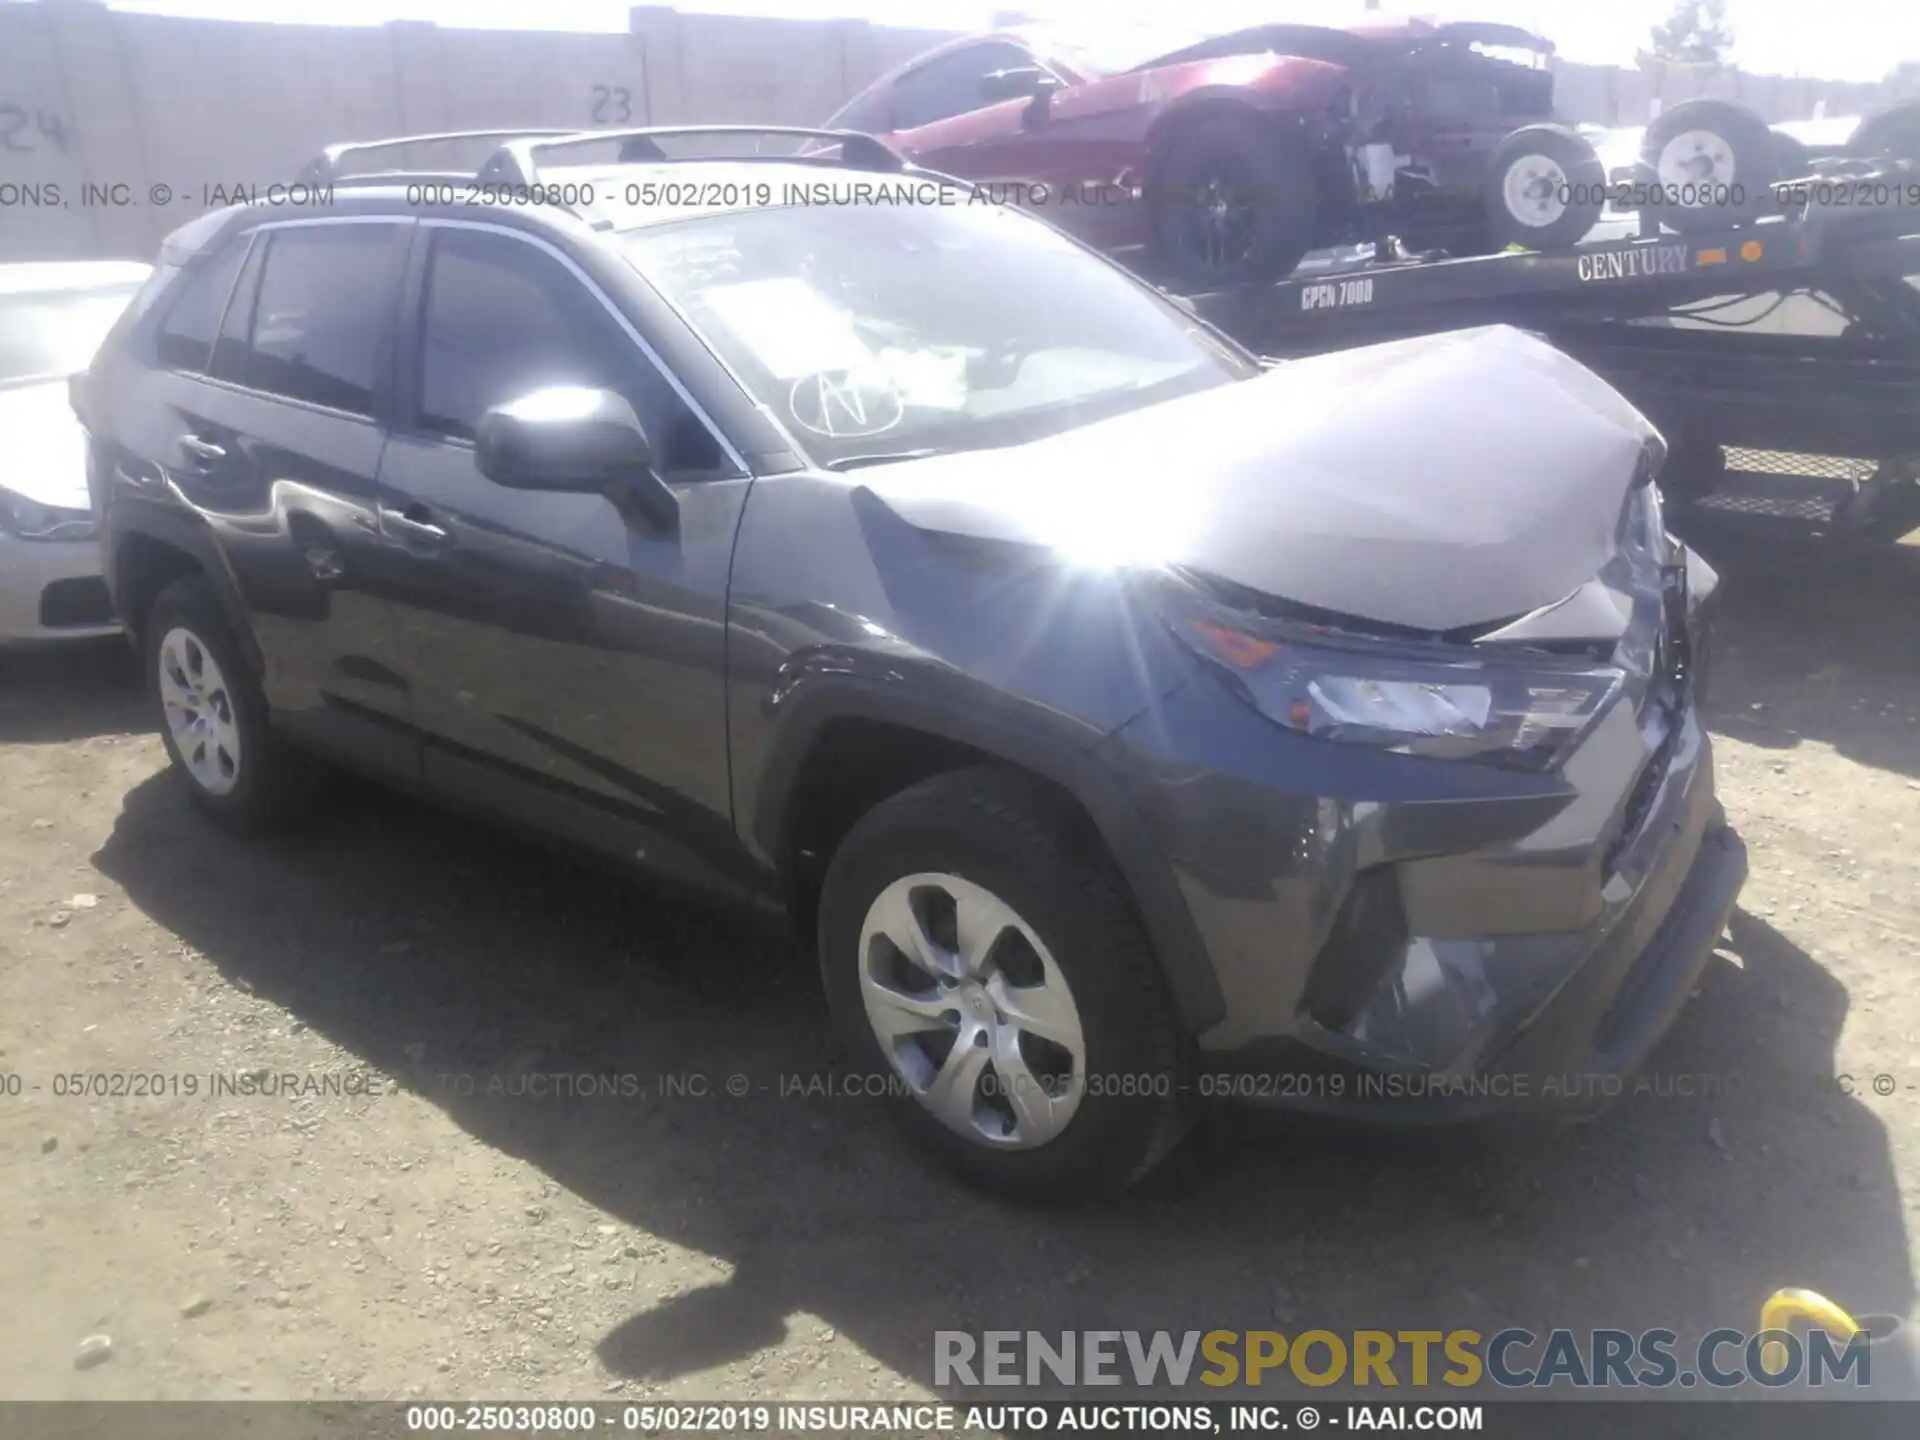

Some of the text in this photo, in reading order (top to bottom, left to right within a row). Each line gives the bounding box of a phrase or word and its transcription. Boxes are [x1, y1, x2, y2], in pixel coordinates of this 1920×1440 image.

[590, 85, 631, 123] 23
[0, 103, 71, 156] 24
[1577, 245, 1689, 281] CENTURY
[1339, 278, 1373, 305] 7000
